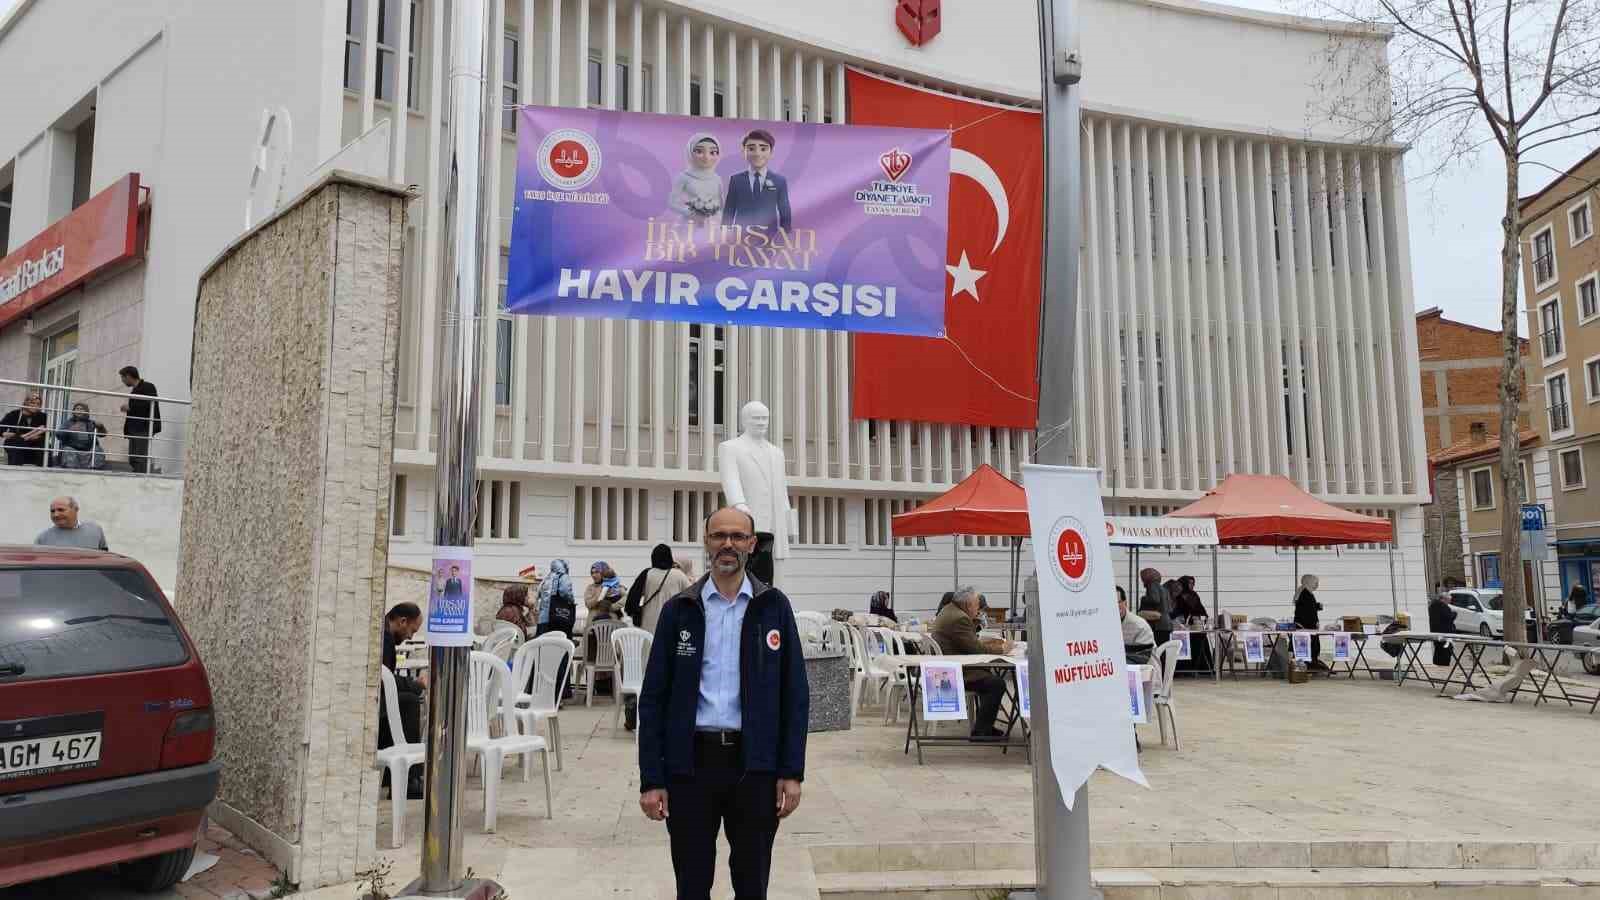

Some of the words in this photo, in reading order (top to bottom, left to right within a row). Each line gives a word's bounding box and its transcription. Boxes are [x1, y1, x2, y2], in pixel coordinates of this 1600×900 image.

[557, 268, 700, 306] HAYIR
[714, 276, 897, 318] ÇARŞISI
[1121, 527, 1152, 537] TAVAS
[1066, 639, 1099, 656] TAVAS
[1054, 657, 1114, 684] MÜFTÜLÜĞÜ
[52, 735, 97, 761] 467
